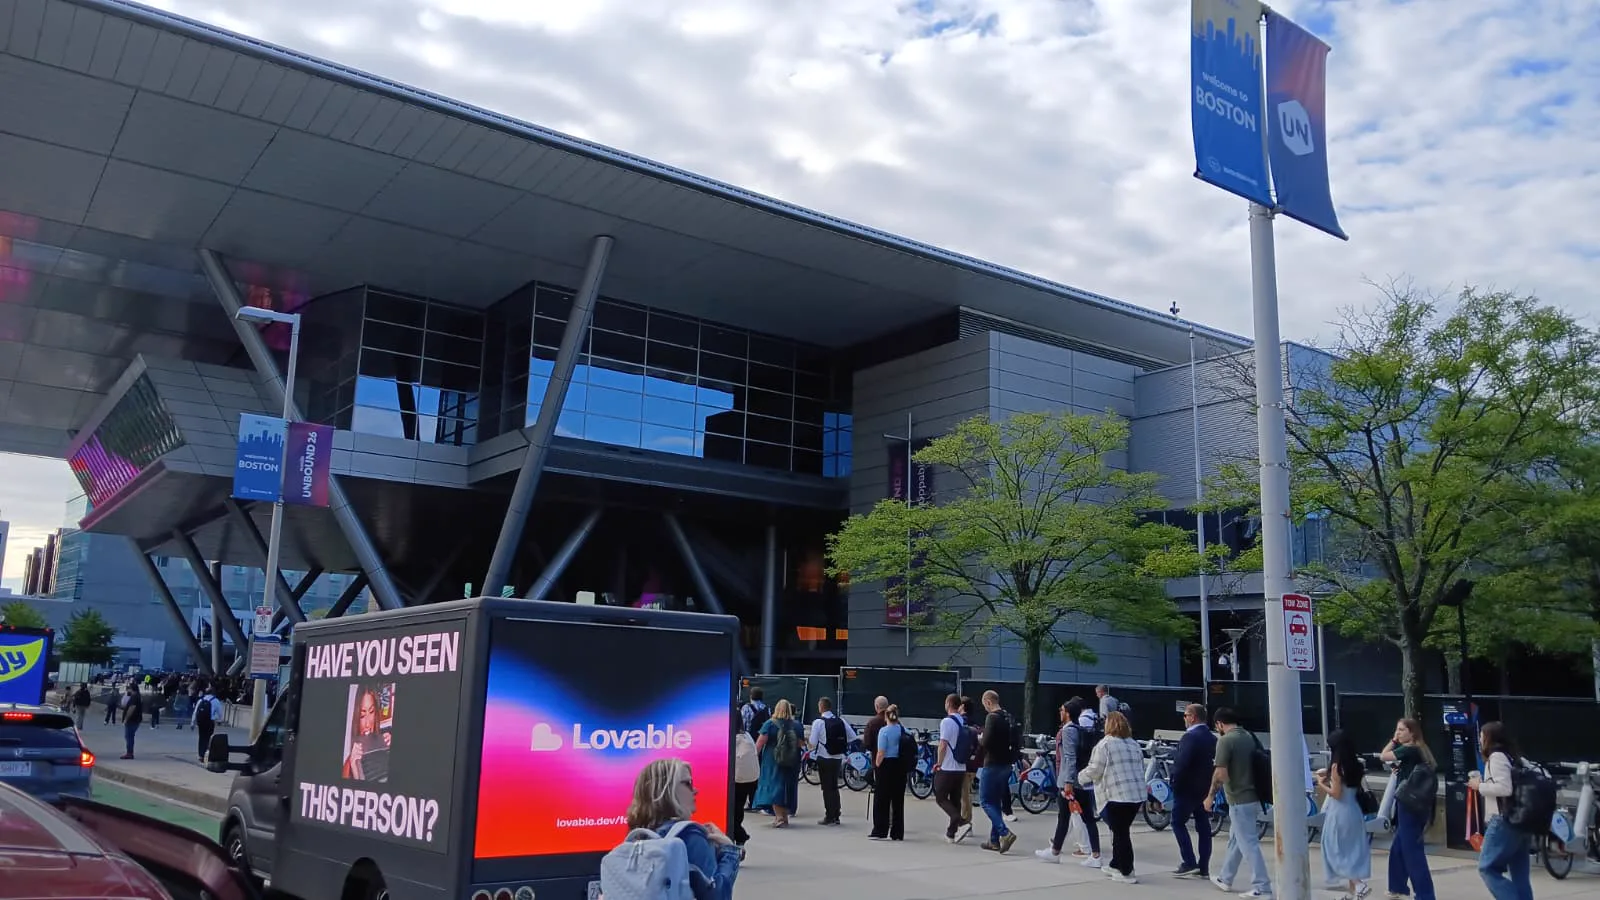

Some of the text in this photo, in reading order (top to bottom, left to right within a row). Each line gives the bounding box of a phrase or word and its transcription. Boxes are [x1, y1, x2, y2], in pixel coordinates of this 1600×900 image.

[1202, 71, 1248, 102] welcome to
[1196, 85, 1256, 132] BOSTON
[1282, 111, 1309, 146] UN
[239, 460, 278, 472] BOSTON
[302, 431, 317, 498] UNBOUND 26
[1284, 599, 1309, 608] TOW ZONE
[306, 642, 355, 679] HAVE
[355, 638, 396, 677] YOU
[397, 631, 460, 675] SEEN
[1292, 647, 1308, 655] STAND
[573, 723, 692, 750] Lovable
[300, 782, 439, 842] THIS PERSON?
